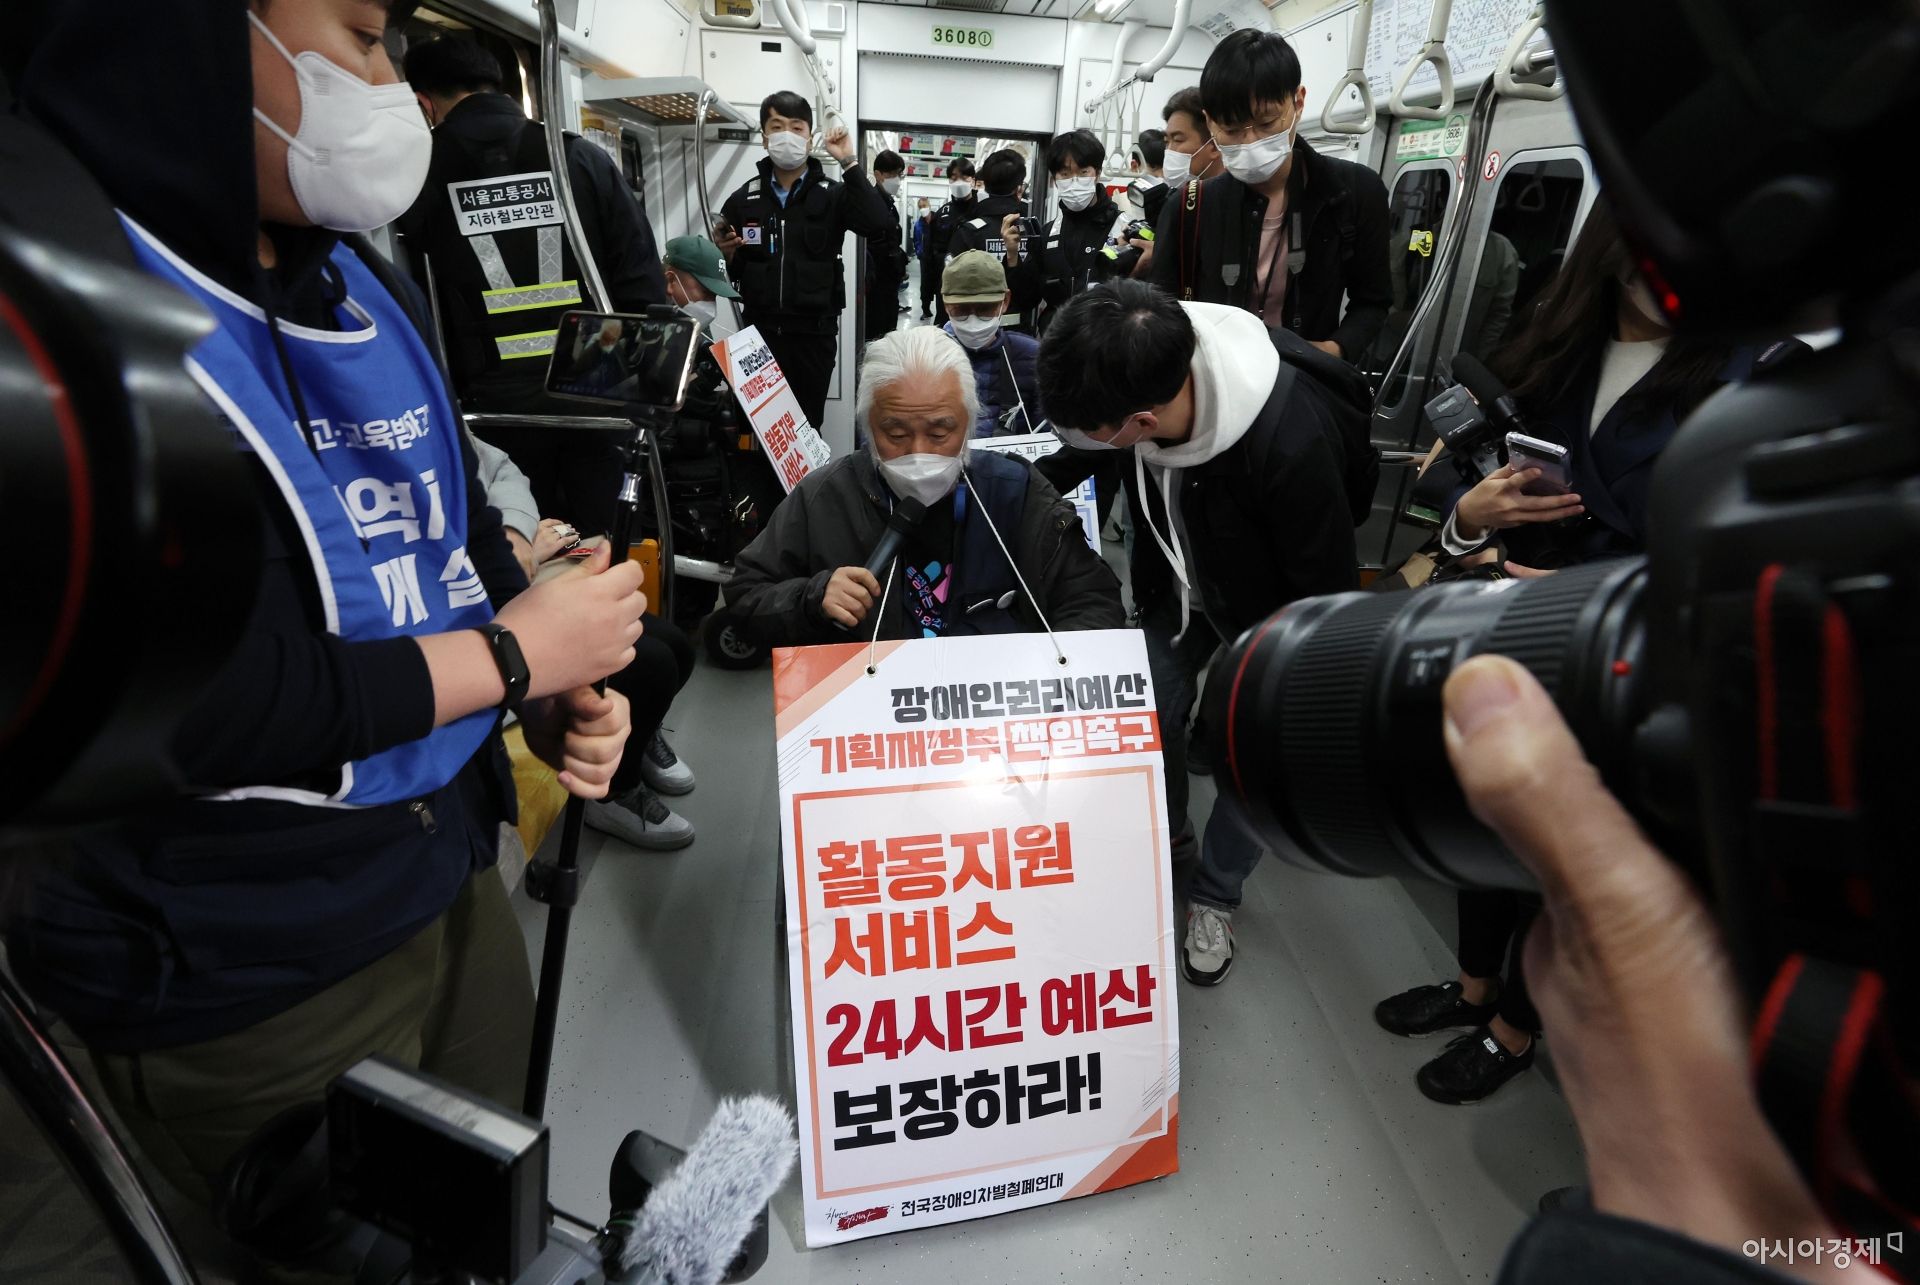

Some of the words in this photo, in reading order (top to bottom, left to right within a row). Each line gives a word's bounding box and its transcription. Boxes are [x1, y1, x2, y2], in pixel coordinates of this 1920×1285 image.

[462, 182, 550, 206] 서울교통공사
[467, 203, 555, 227] 지하철보안관
[890, 673, 1148, 723] 장애인권리예산
[809, 726, 1001, 774] 기획재정부
[1009, 716, 1155, 759] 책임촉구
[817, 822, 1074, 909] 활동지원
[824, 901, 1016, 980] 서비스
[825, 982, 1027, 1067] 24시간
[1040, 964, 1157, 1036] 예산
[833, 1051, 1102, 1151] 보장하라!
[901, 1172, 1064, 1217] 전국장애인차별철폐연대
